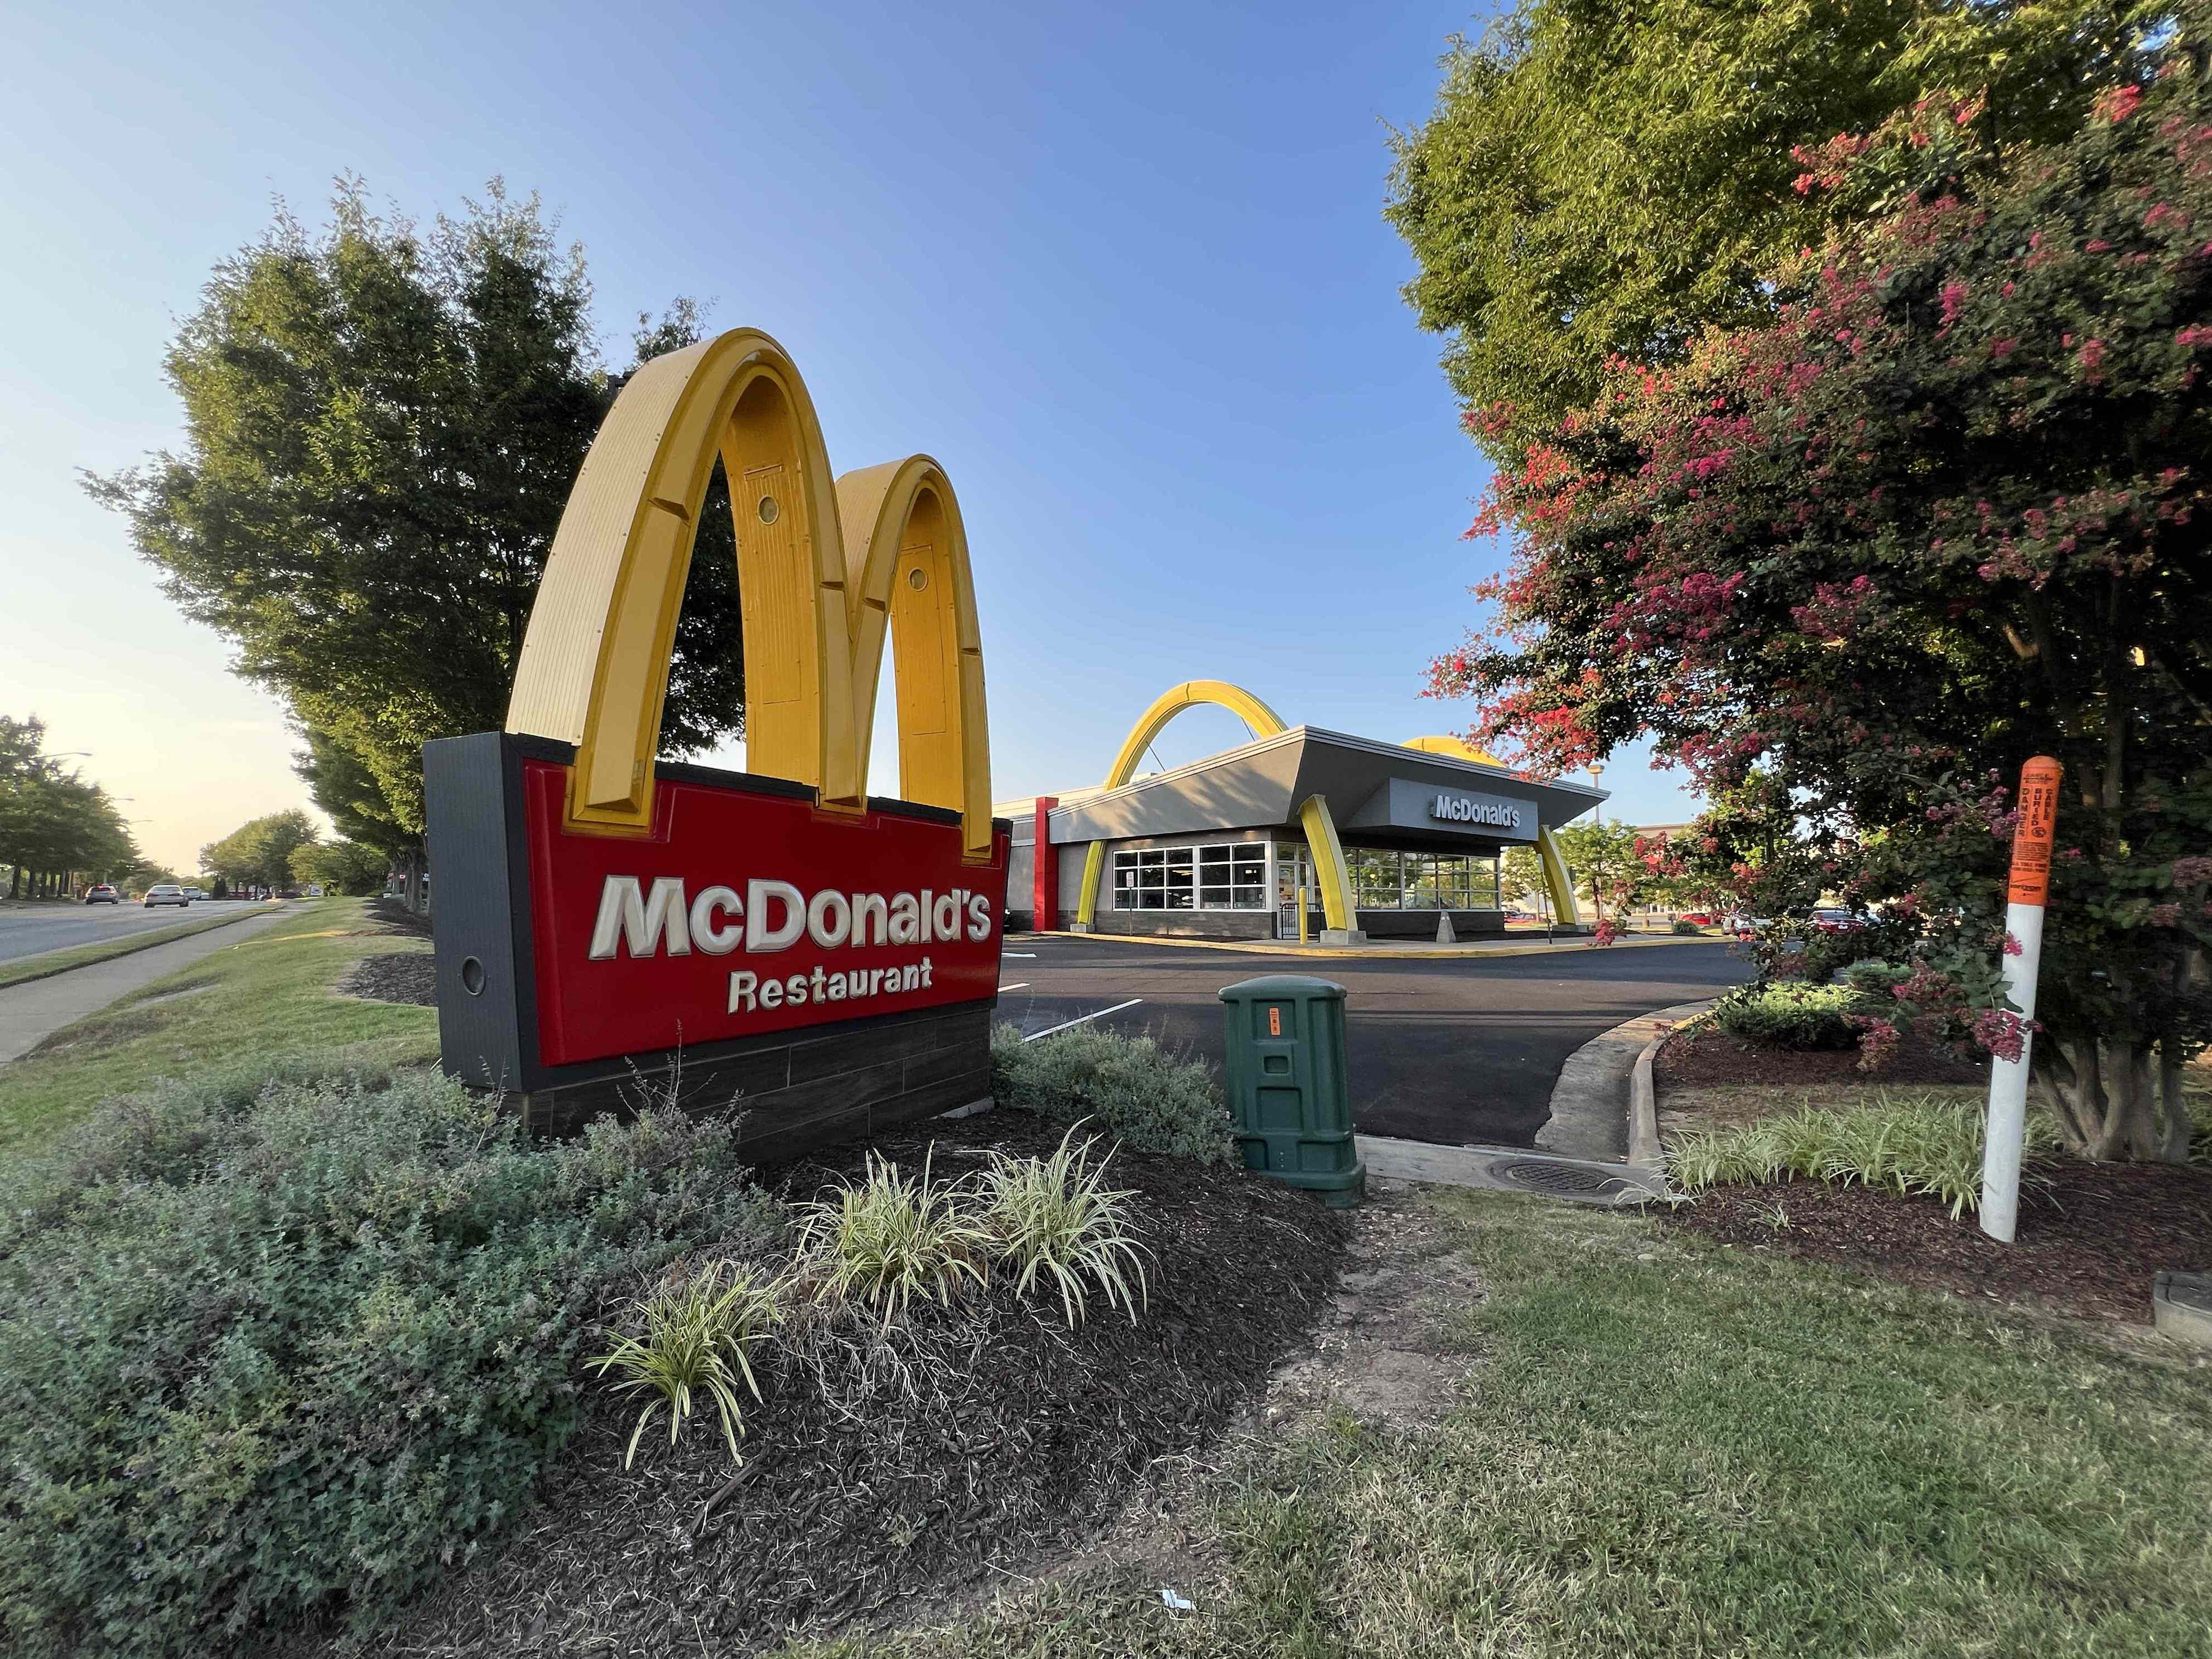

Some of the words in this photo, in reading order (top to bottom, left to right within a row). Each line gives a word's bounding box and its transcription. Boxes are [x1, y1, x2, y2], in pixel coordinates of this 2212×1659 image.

[1435, 795, 1520, 827] McDonald's
[2018, 787, 2030, 836] DANGER
[2031, 787, 2042, 826] BURIED
[2043, 788, 2054, 821] CABLE
[589, 874, 991, 960] McDonald's
[727, 956, 933, 1015] Restaurant
